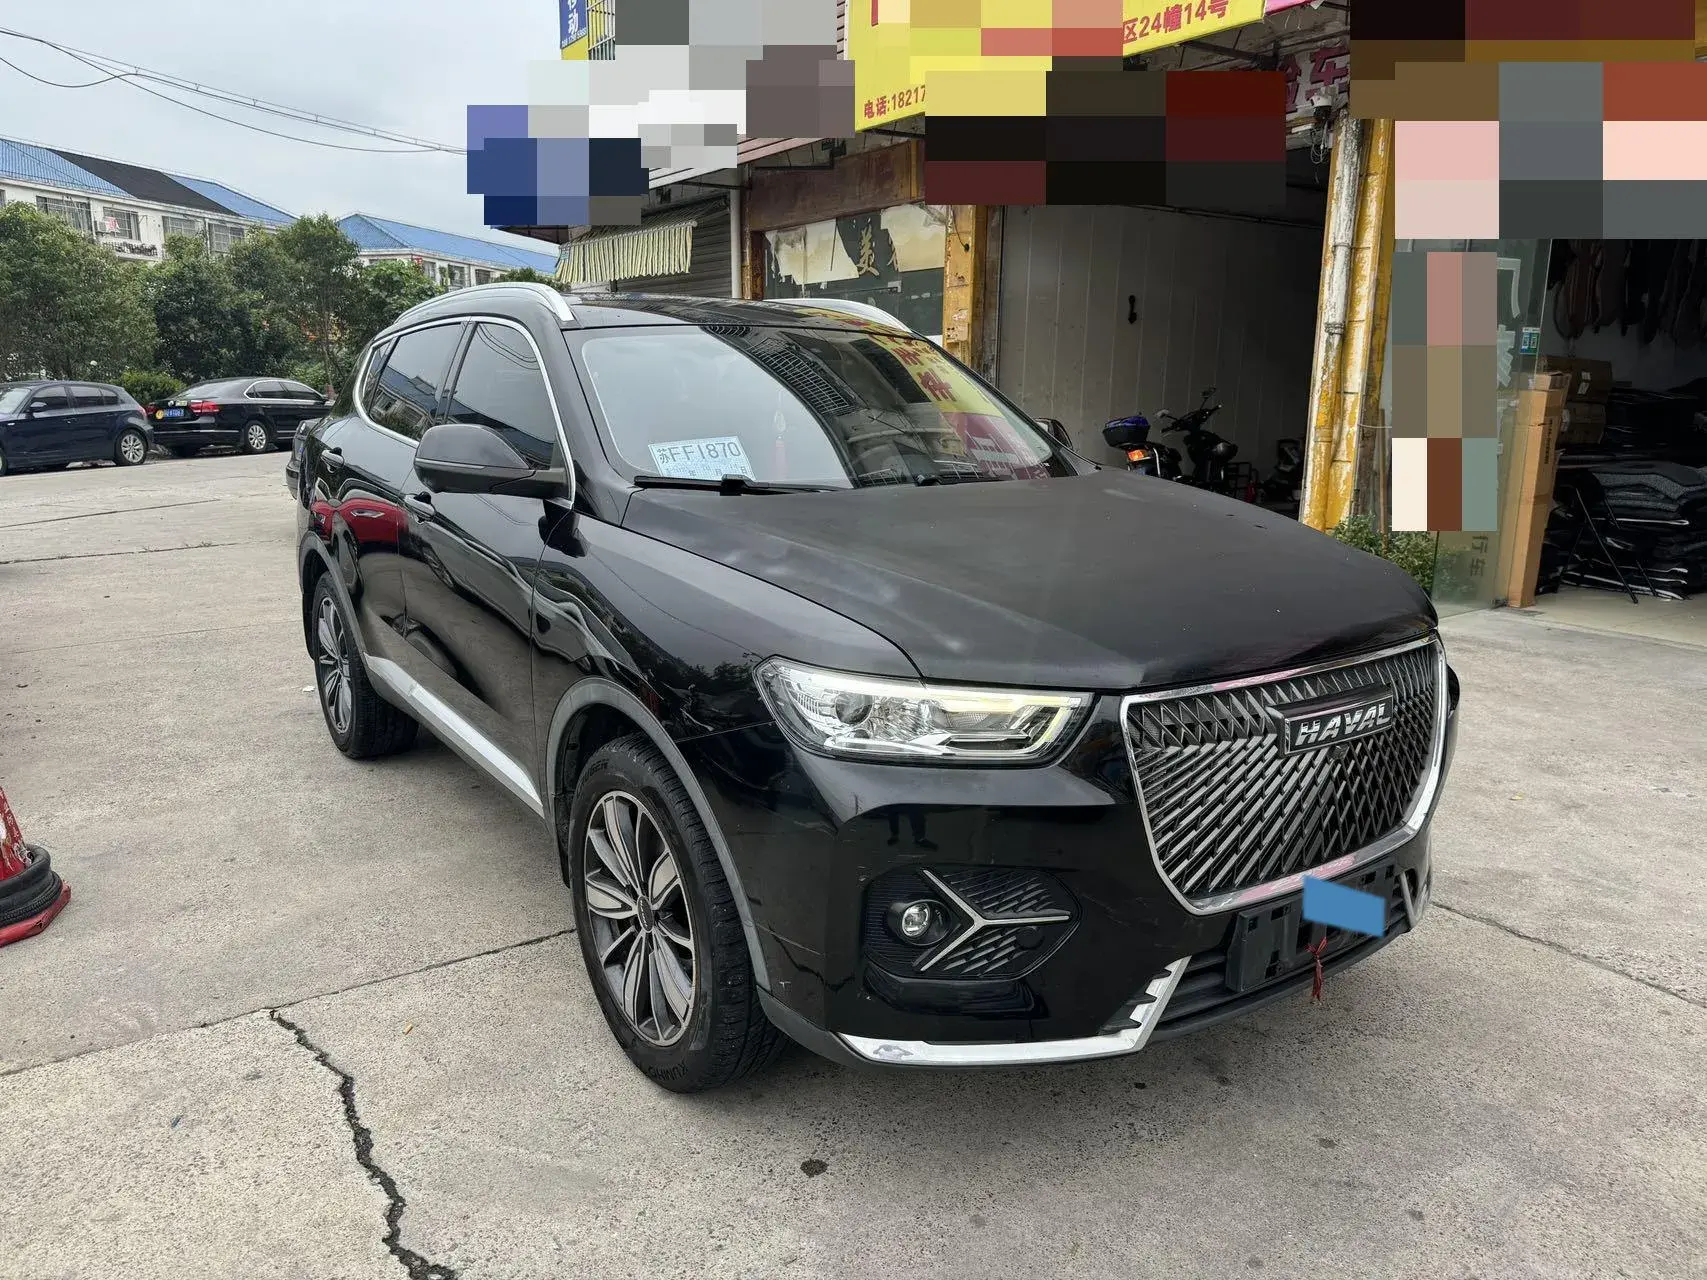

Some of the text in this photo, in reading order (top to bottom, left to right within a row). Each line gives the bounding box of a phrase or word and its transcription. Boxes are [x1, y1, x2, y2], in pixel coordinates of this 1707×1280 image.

[1122, 0, 1229, 44] 区24幢14号
[1295, 702, 1391, 746] HAVAL
